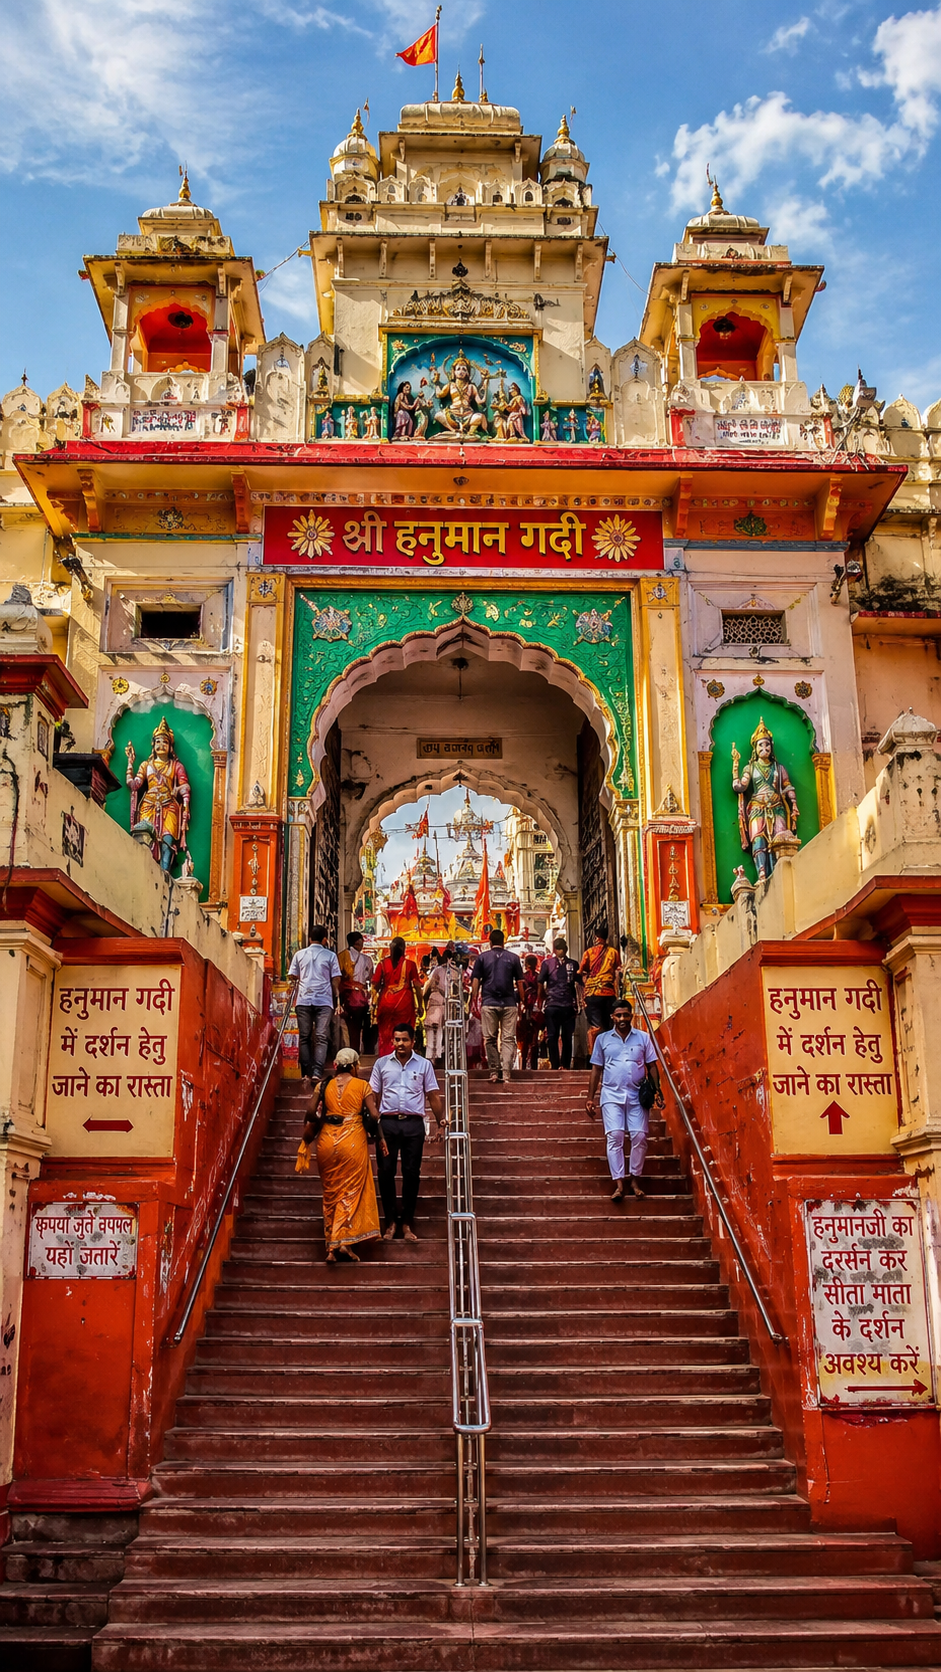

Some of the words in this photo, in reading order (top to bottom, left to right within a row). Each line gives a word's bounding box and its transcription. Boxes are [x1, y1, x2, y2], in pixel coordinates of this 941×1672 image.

[342, 510, 387, 553] श्री
[394, 521, 509, 565] हनुमान
[59, 988, 130, 1020] हनुमान
[768, 988, 837, 1020] हनुमान
[61, 1027, 78, 1056] में
[85, 1027, 131, 1058] दर्शन
[138, 1027, 167, 1065] हेतु
[776, 1026, 793, 1055] में
[800, 1026, 846, 1058] दर्शन
[853, 1026, 883, 1064] हेतु
[52, 1067, 90, 1097] जाने
[96, 1076, 122, 1097] का
[127, 1076, 173, 1097] रास्ता
[773, 1065, 810, 1096] जाने
[815, 1074, 841, 1095] का
[845, 1074, 893, 1095] रास्ता
[812, 1208, 887, 1243] हनुमानजी
[892, 1216, 914, 1237] का
[878, 1250, 908, 1271] कर
[823, 1276, 865, 1305] सीता
[871, 1284, 912, 1304] माता
[832, 1310, 851, 1341] के
[859, 1311, 905, 1342] दर्शन
[824, 1353, 883, 1375] अवश्य
[889, 1345, 920, 1374] करें
